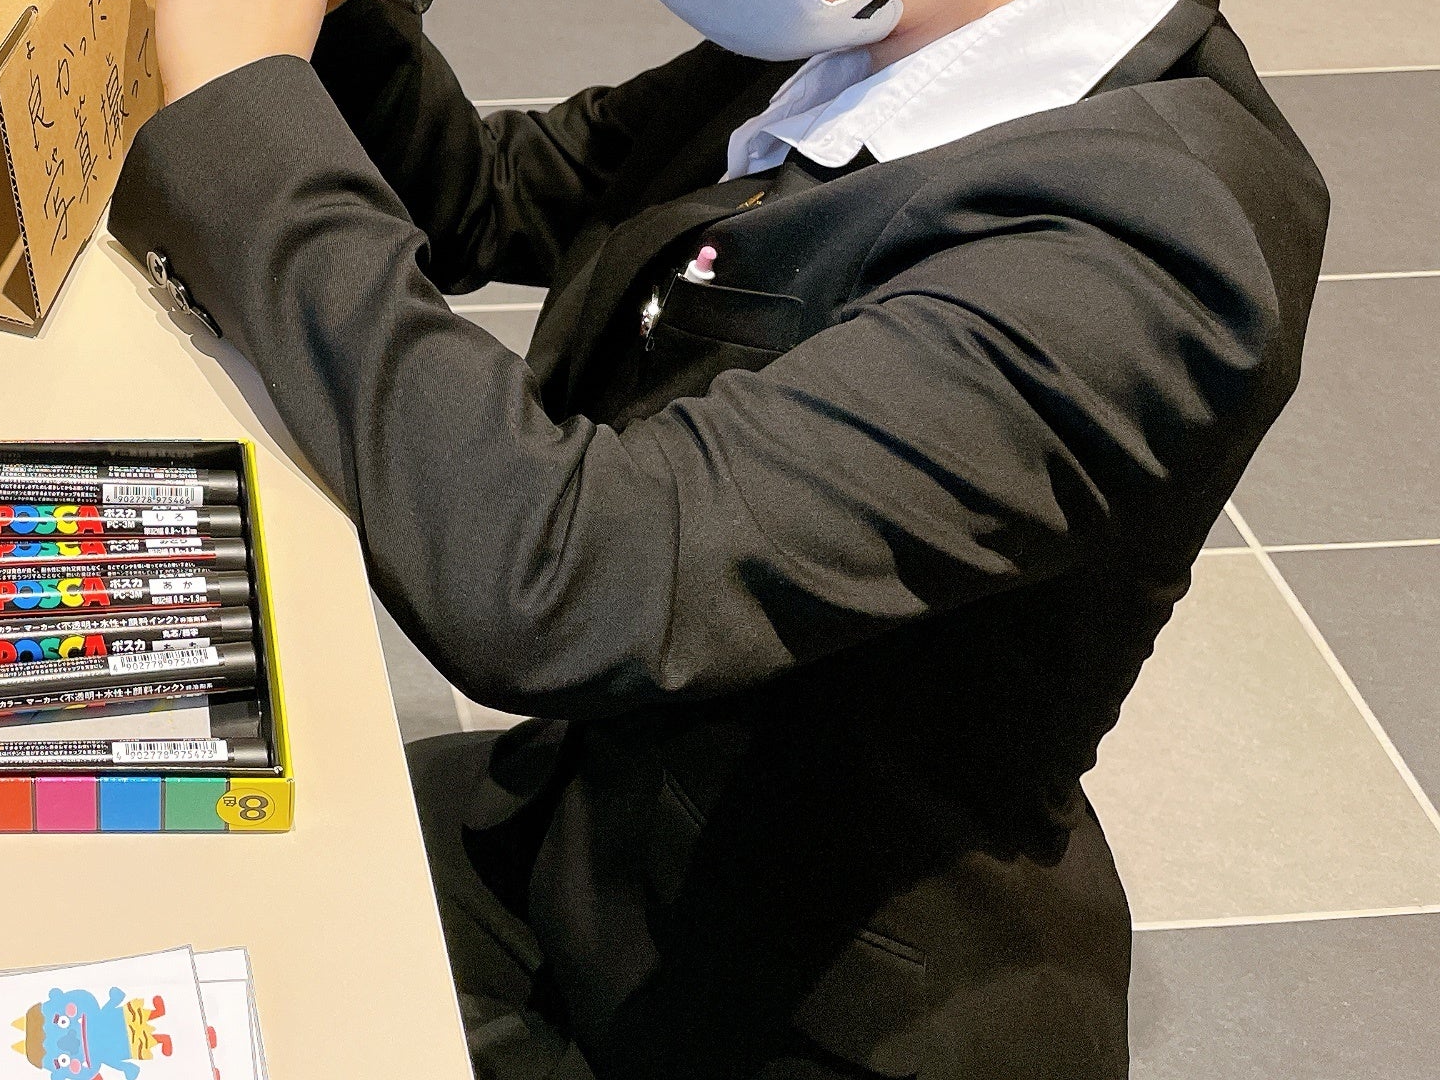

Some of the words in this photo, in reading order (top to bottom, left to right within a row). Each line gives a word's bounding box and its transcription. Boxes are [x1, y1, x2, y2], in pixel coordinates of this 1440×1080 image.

[103, 508, 137, 519] ポスカ
[106, 520, 136, 529] PC-3M
[110, 543, 139, 551] PC-3M
[110, 578, 143, 588] ポスカ
[113, 590, 144, 600] PC-3M
[111, 639, 146, 652] ポスカ
